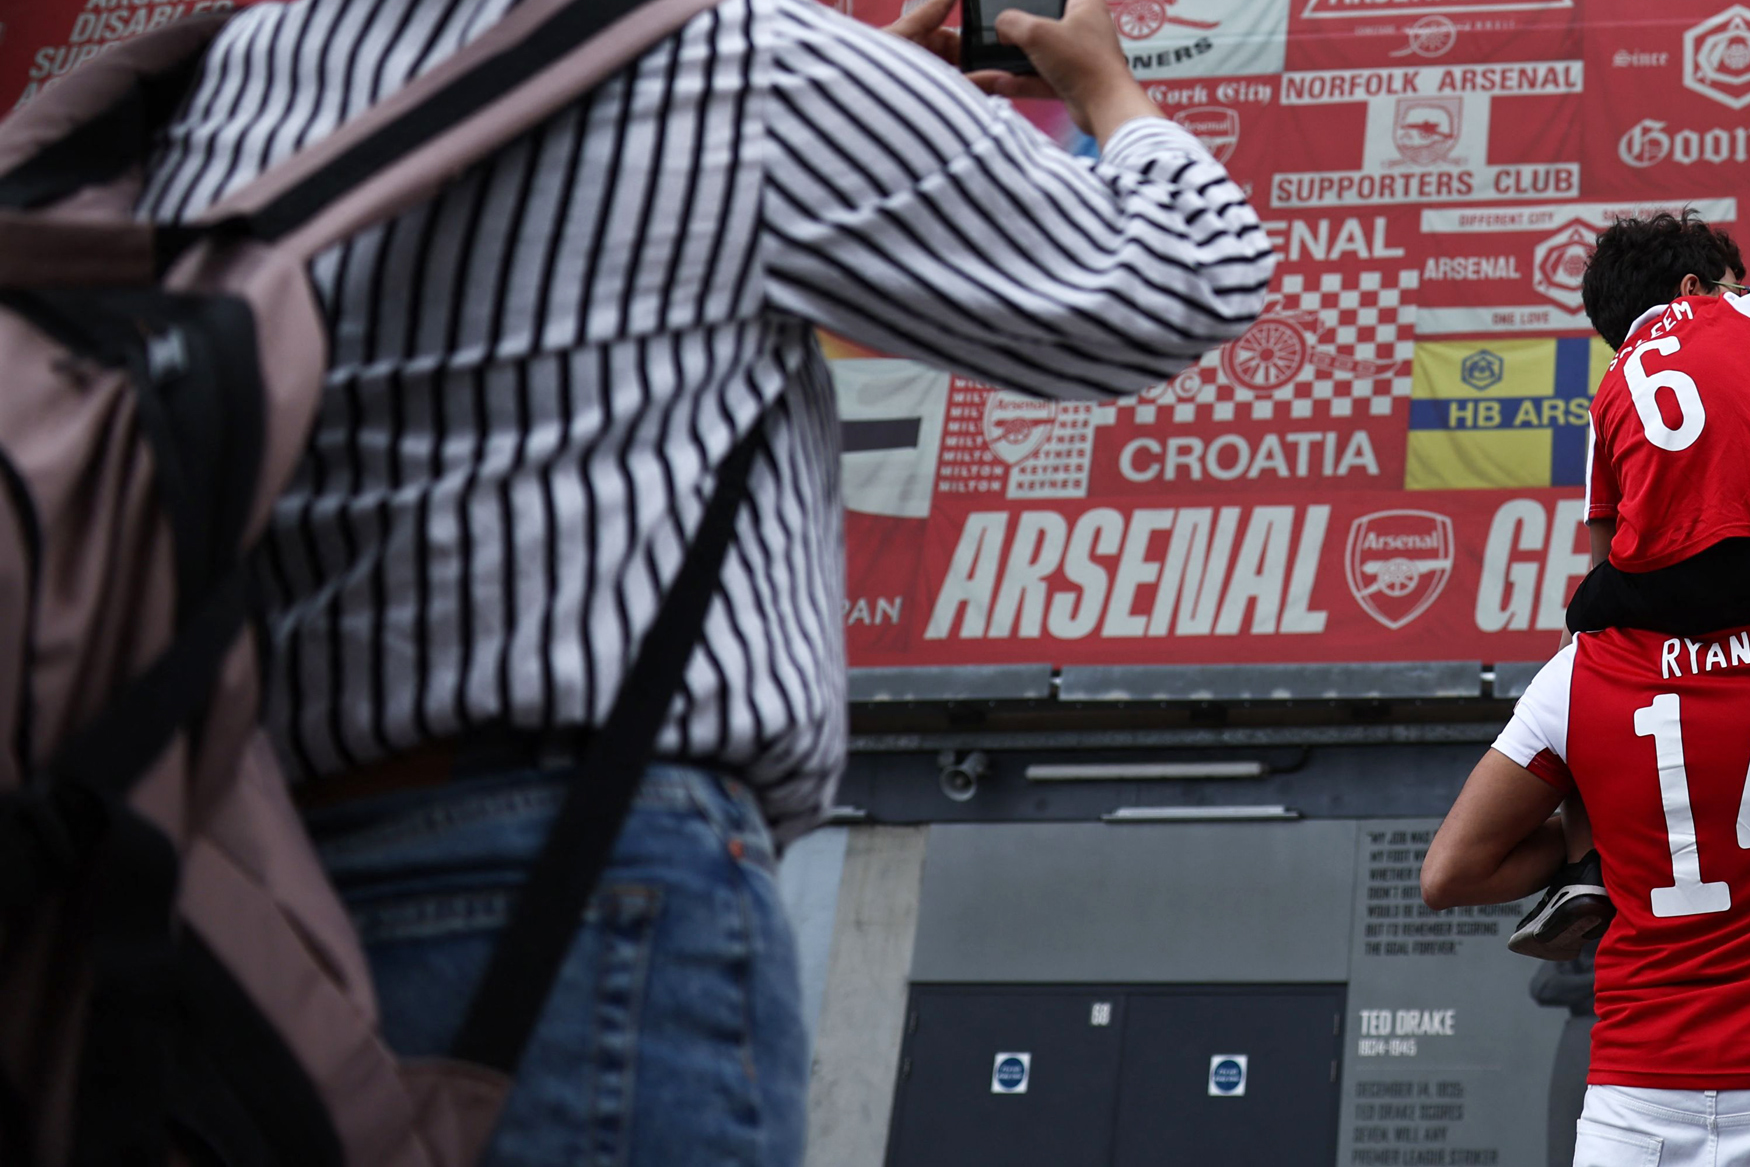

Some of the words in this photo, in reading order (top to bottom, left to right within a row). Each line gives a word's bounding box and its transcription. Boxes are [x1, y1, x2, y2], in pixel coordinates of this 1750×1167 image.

[1612, 49, 1669, 67] Since
[1285, 74, 1418, 102] NORFOLK
[1438, 66, 1578, 95] ARSENAL
[1277, 174, 1473, 204] SUPPORTERS
[1495, 168, 1574, 193] CLUB
[1424, 258, 1520, 280] ARSENAL
[1623, 336, 1706, 451] 6
[1448, 402, 1502, 428] HB
[1118, 432, 1379, 482] CROATIA
[1362, 532, 1440, 550] Arsenal
[924, 504, 1331, 640] ARSENAL
[1457, 923, 1499, 936] SCORING
[1366, 942, 1382, 955] THE
[1385, 942, 1408, 955] GOAL
[1360, 1010, 1389, 1035] TED
[1396, 1010, 1455, 1035] DRAKE
